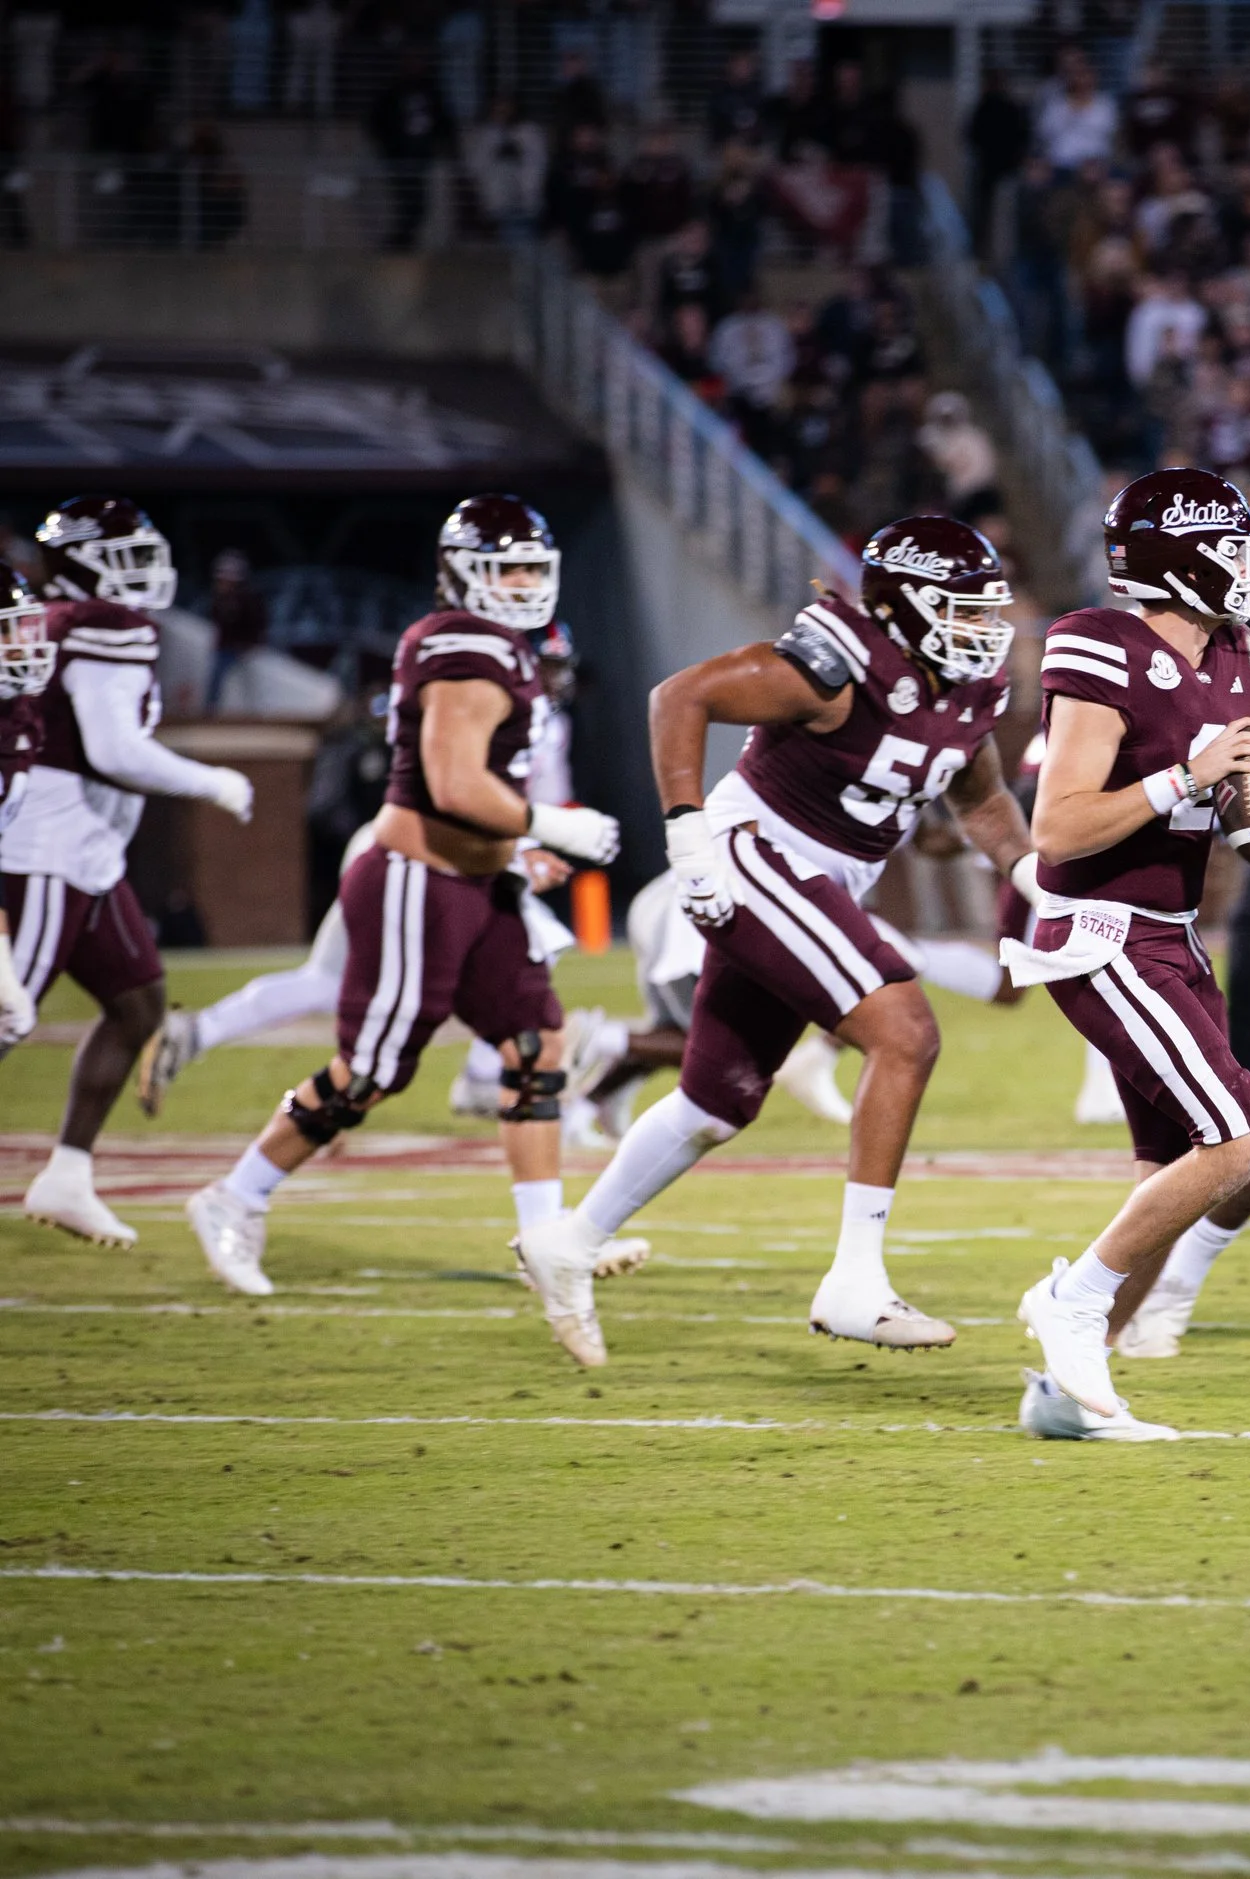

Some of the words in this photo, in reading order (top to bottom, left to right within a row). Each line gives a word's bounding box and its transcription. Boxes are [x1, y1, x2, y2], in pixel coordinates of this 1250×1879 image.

[1160, 493, 1238, 531] State
[882, 536, 946, 572] State
[1080, 915, 1125, 943] STATE
